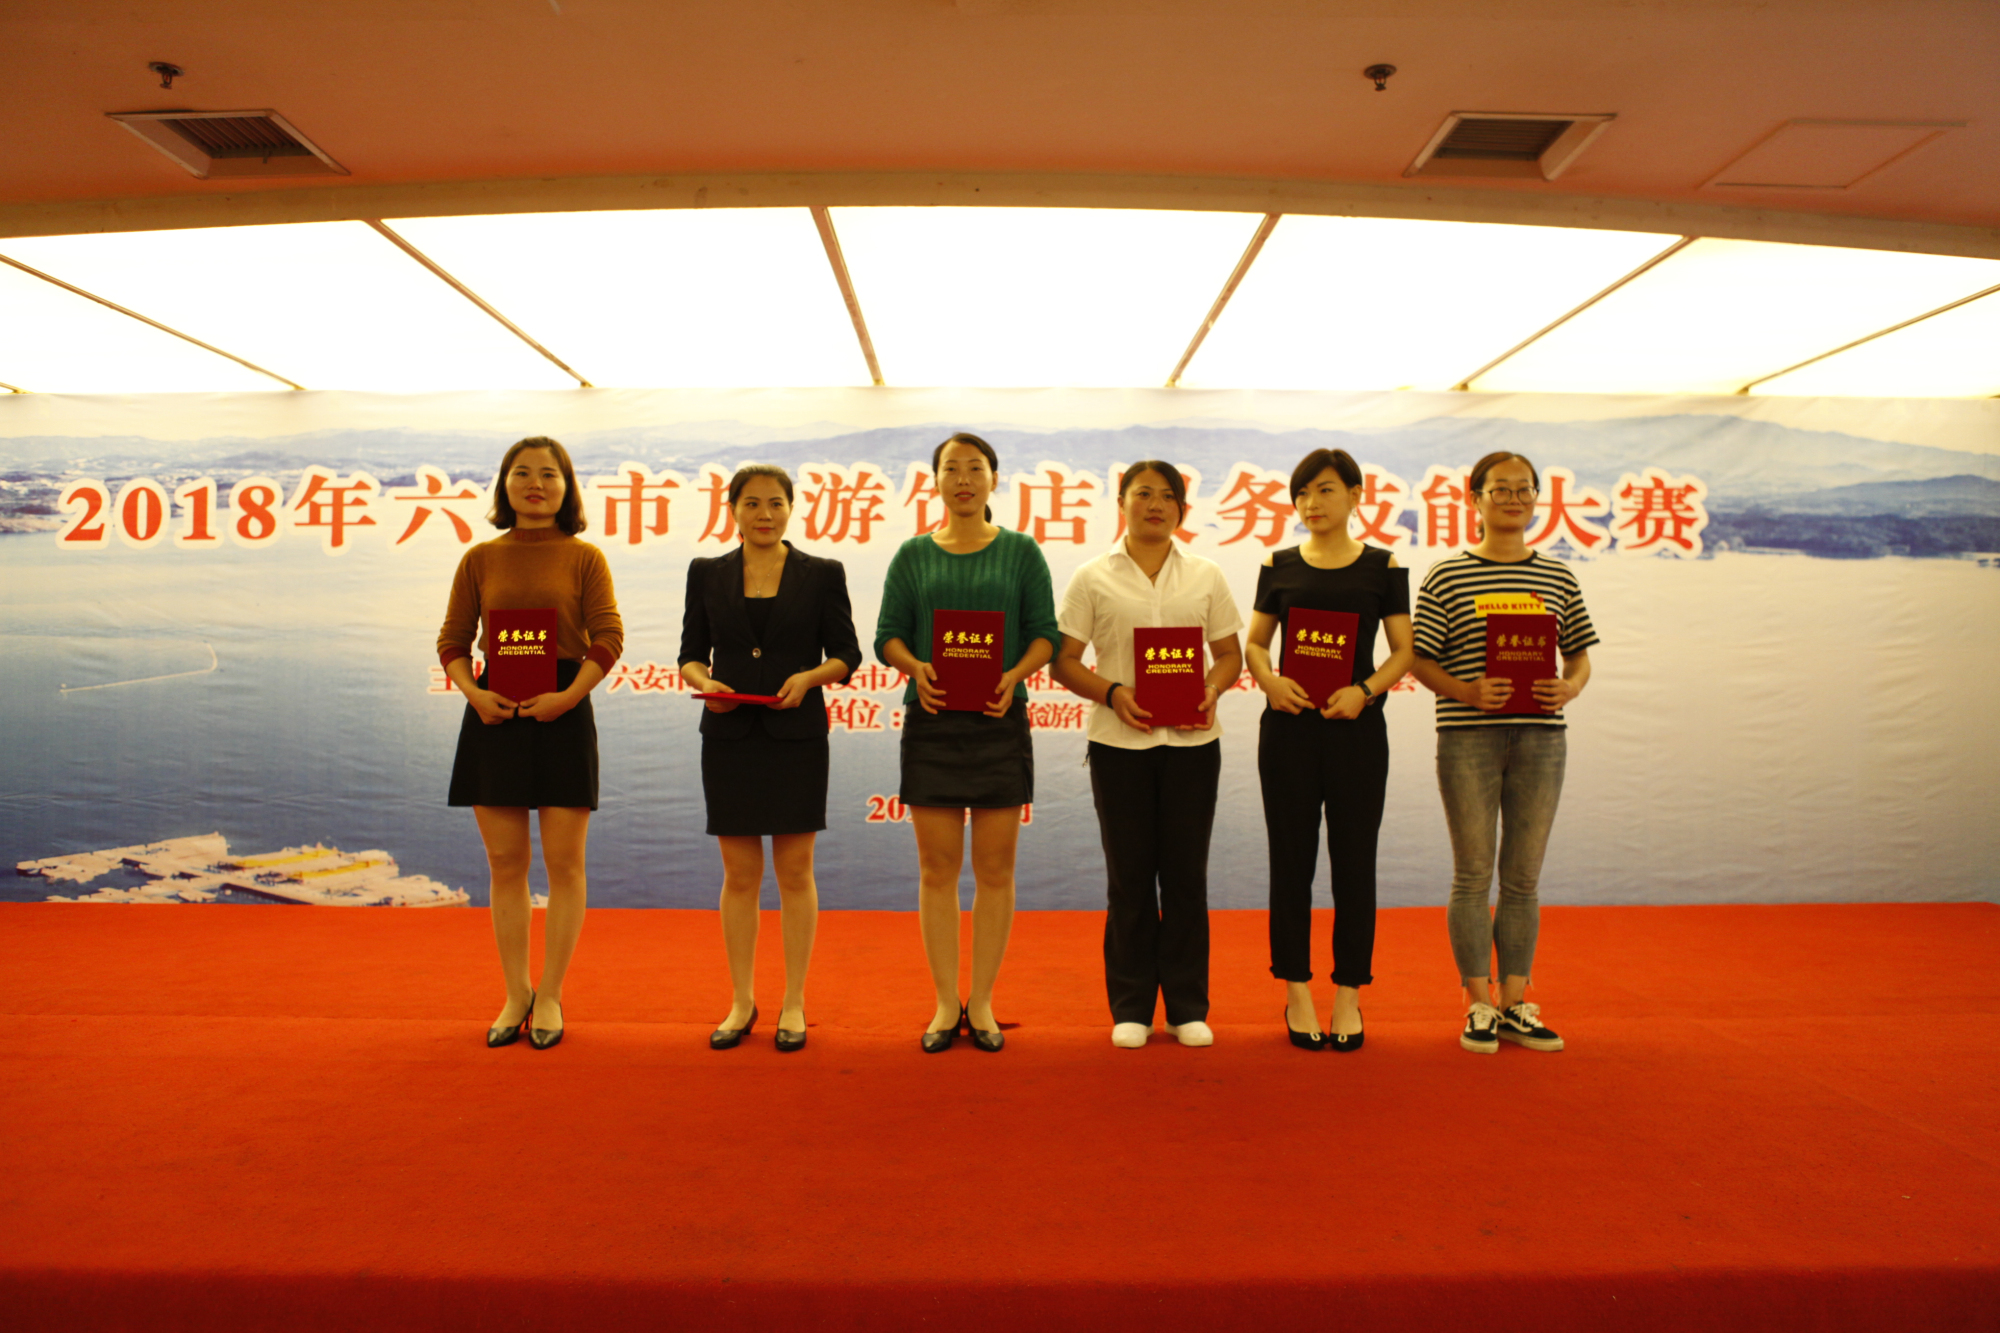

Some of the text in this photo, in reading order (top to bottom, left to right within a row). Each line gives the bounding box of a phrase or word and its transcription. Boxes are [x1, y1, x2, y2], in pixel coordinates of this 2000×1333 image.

[64, 470, 1699, 550] 2018年六市游店务技能大赛
[1478, 603, 1508, 611] HELLO
[498, 629, 547, 643] 荣誉证书
[943, 630, 994, 645] 荣誉证书
[1296, 628, 1346, 647] 荣誉证书
[943, 651, 992, 659] CREDENTIAL
[1145, 647, 1195, 660] 荣誉证书
[1295, 648, 1343, 660] CREDENTIAL
[1297, 645, 1341, 655] HONORARY
